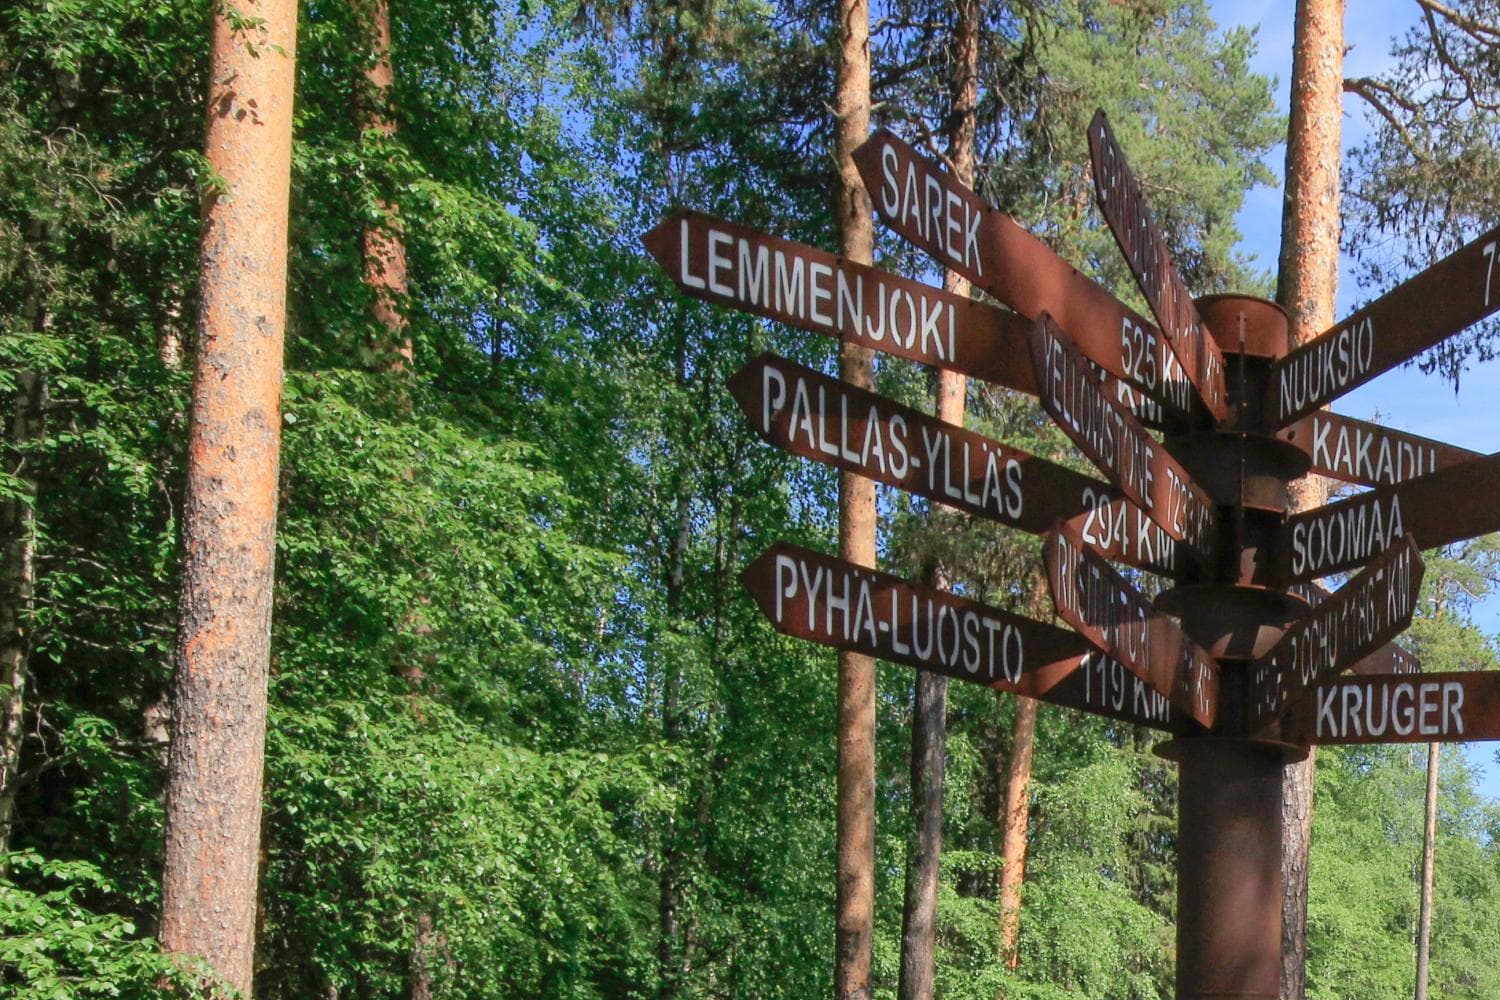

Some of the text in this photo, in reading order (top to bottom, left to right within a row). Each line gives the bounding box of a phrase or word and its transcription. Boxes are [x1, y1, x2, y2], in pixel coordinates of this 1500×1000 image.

[680, 218, 955, 363] LEMMENJOKI
[881, 143, 983, 277] SAREK
[1121, 317, 1156, 391] 525
[1162, 343, 1191, 416] KM
[1043, 320, 1154, 509] YELLOWSTONE
[1280, 316, 1374, 420] NUUKSIO
[762, 364, 1176, 572] PALLAS-YLLÄS 294 KM
[1292, 493, 1404, 577] SOOMAA
[775, 553, 1024, 686] PYHÄ-LUOSTO
[1079, 648, 1126, 712] 119
[1133, 675, 1171, 724] KM
[1386, 545, 1411, 630] KM
[1315, 680, 1465, 738] KRUGER
